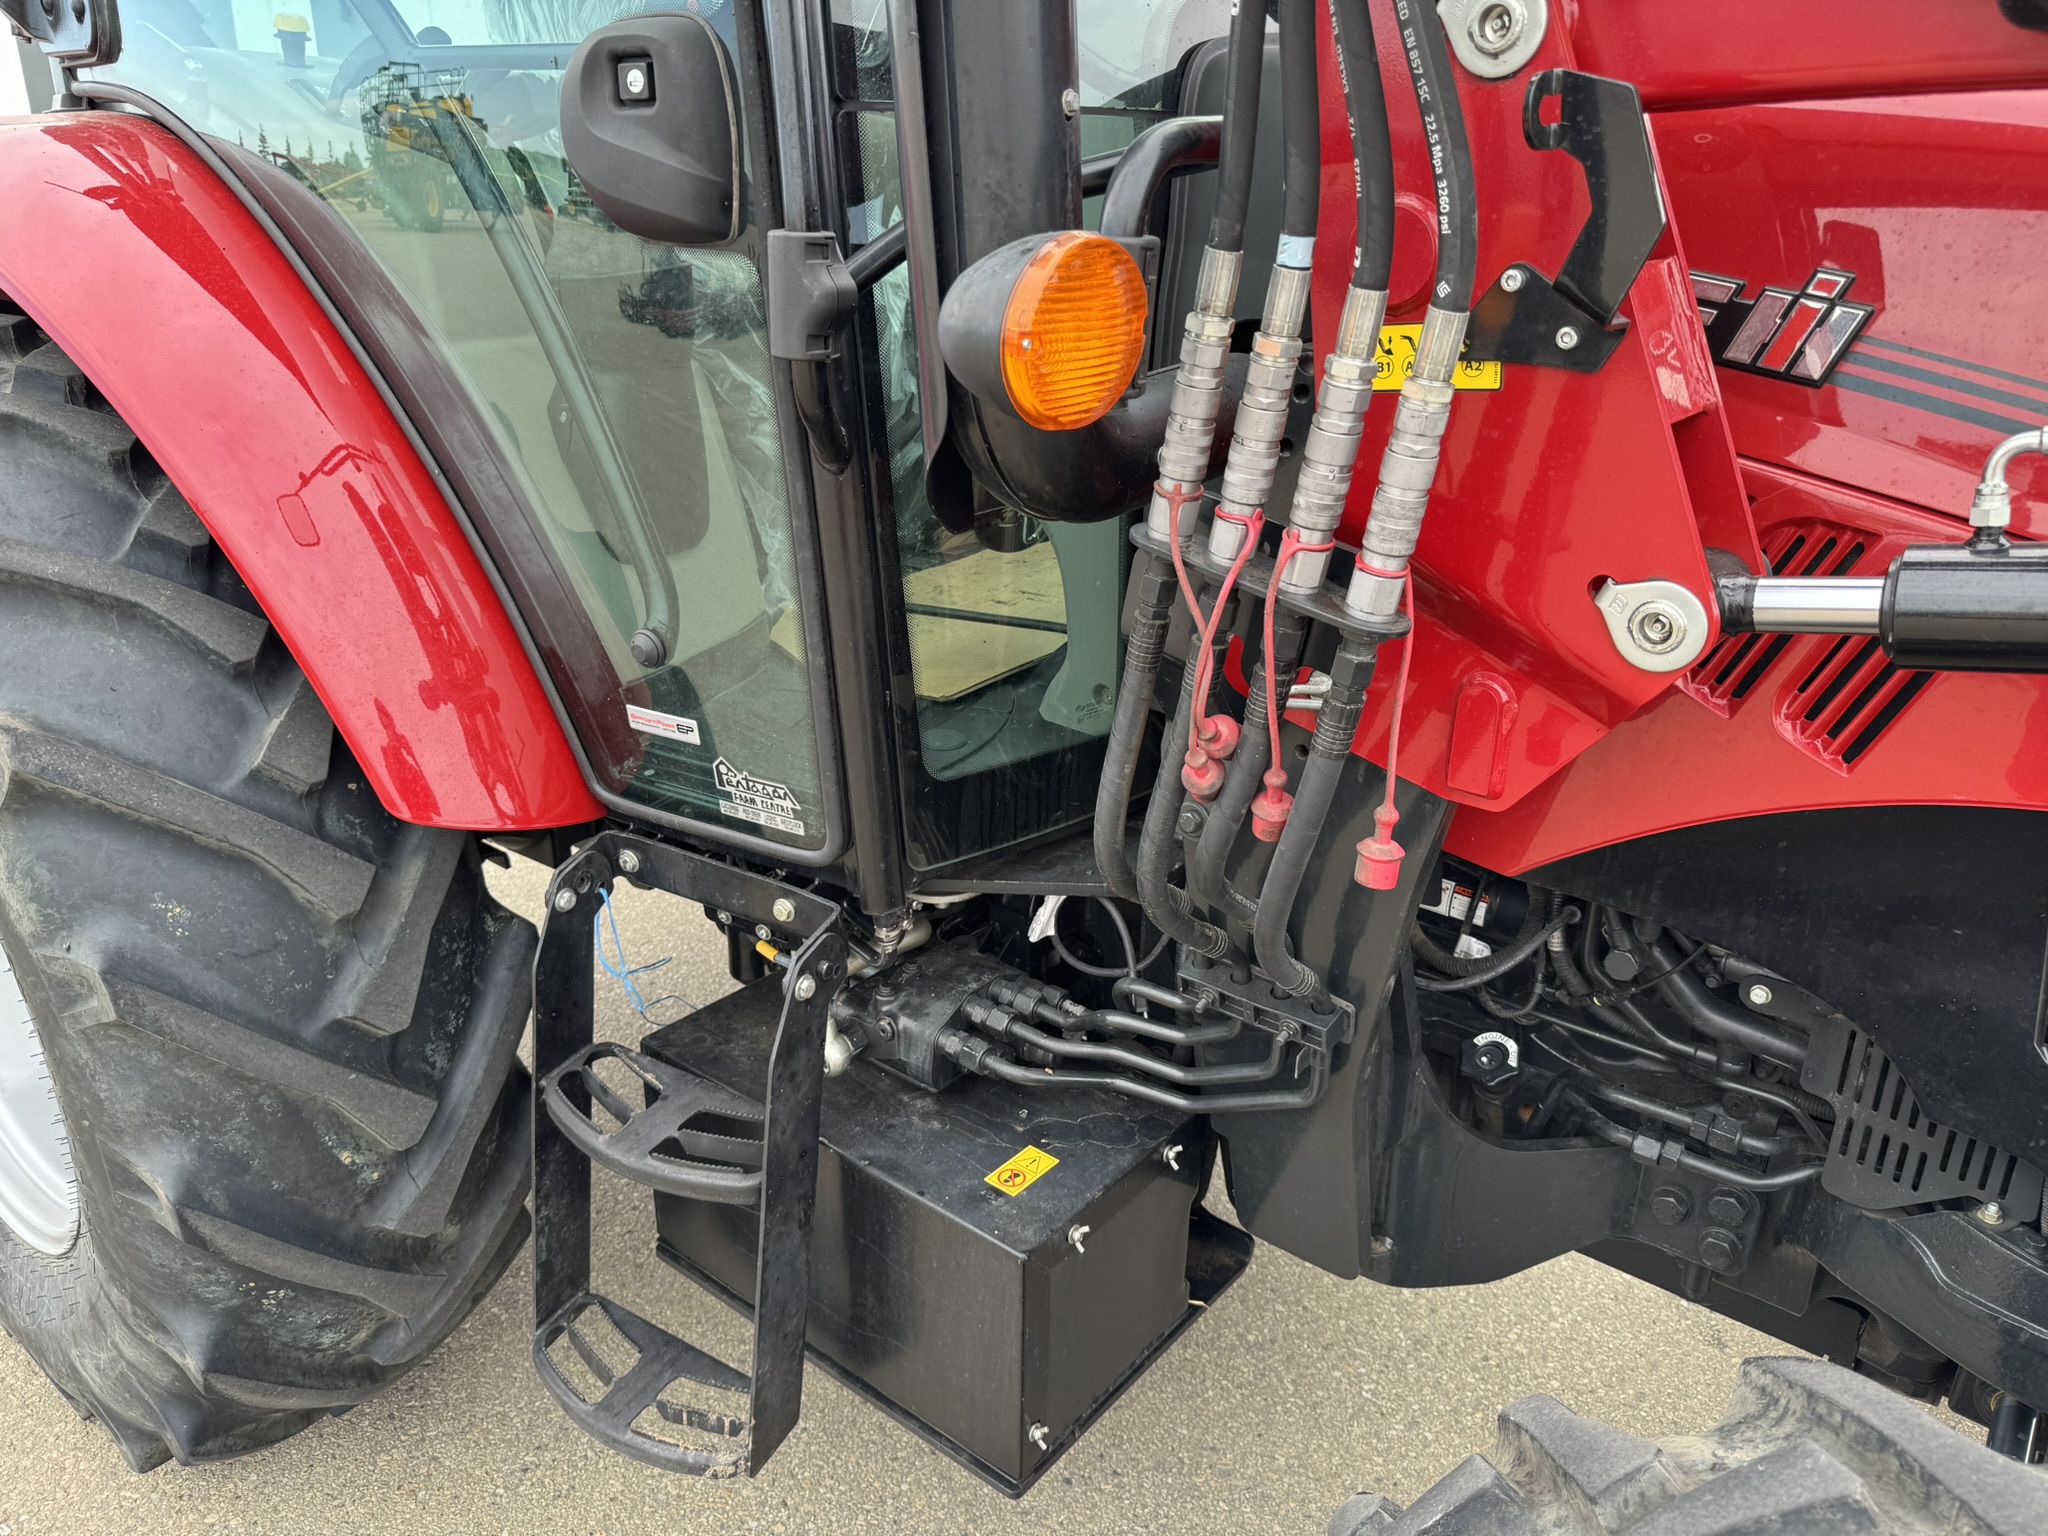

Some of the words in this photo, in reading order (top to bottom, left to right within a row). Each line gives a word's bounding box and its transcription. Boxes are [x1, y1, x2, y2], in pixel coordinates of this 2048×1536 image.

[1403, 27, 1416, 49] EN
[1409, 49, 1424, 74] 857
[1424, 113, 1439, 144] 22.5
[1432, 145, 1443, 175] Mpa
[1437, 179, 1450, 213] 3260
[1440, 215, 1451, 234] psi
[1464, 360, 1482, 371] A2
[676, 723, 694, 735] EP
[714, 760, 797, 807] Pentagon
[734, 792, 759, 807] FARM
[760, 799, 791, 816] CENTRE
[1475, 1033, 1511, 1045] ENGINE
